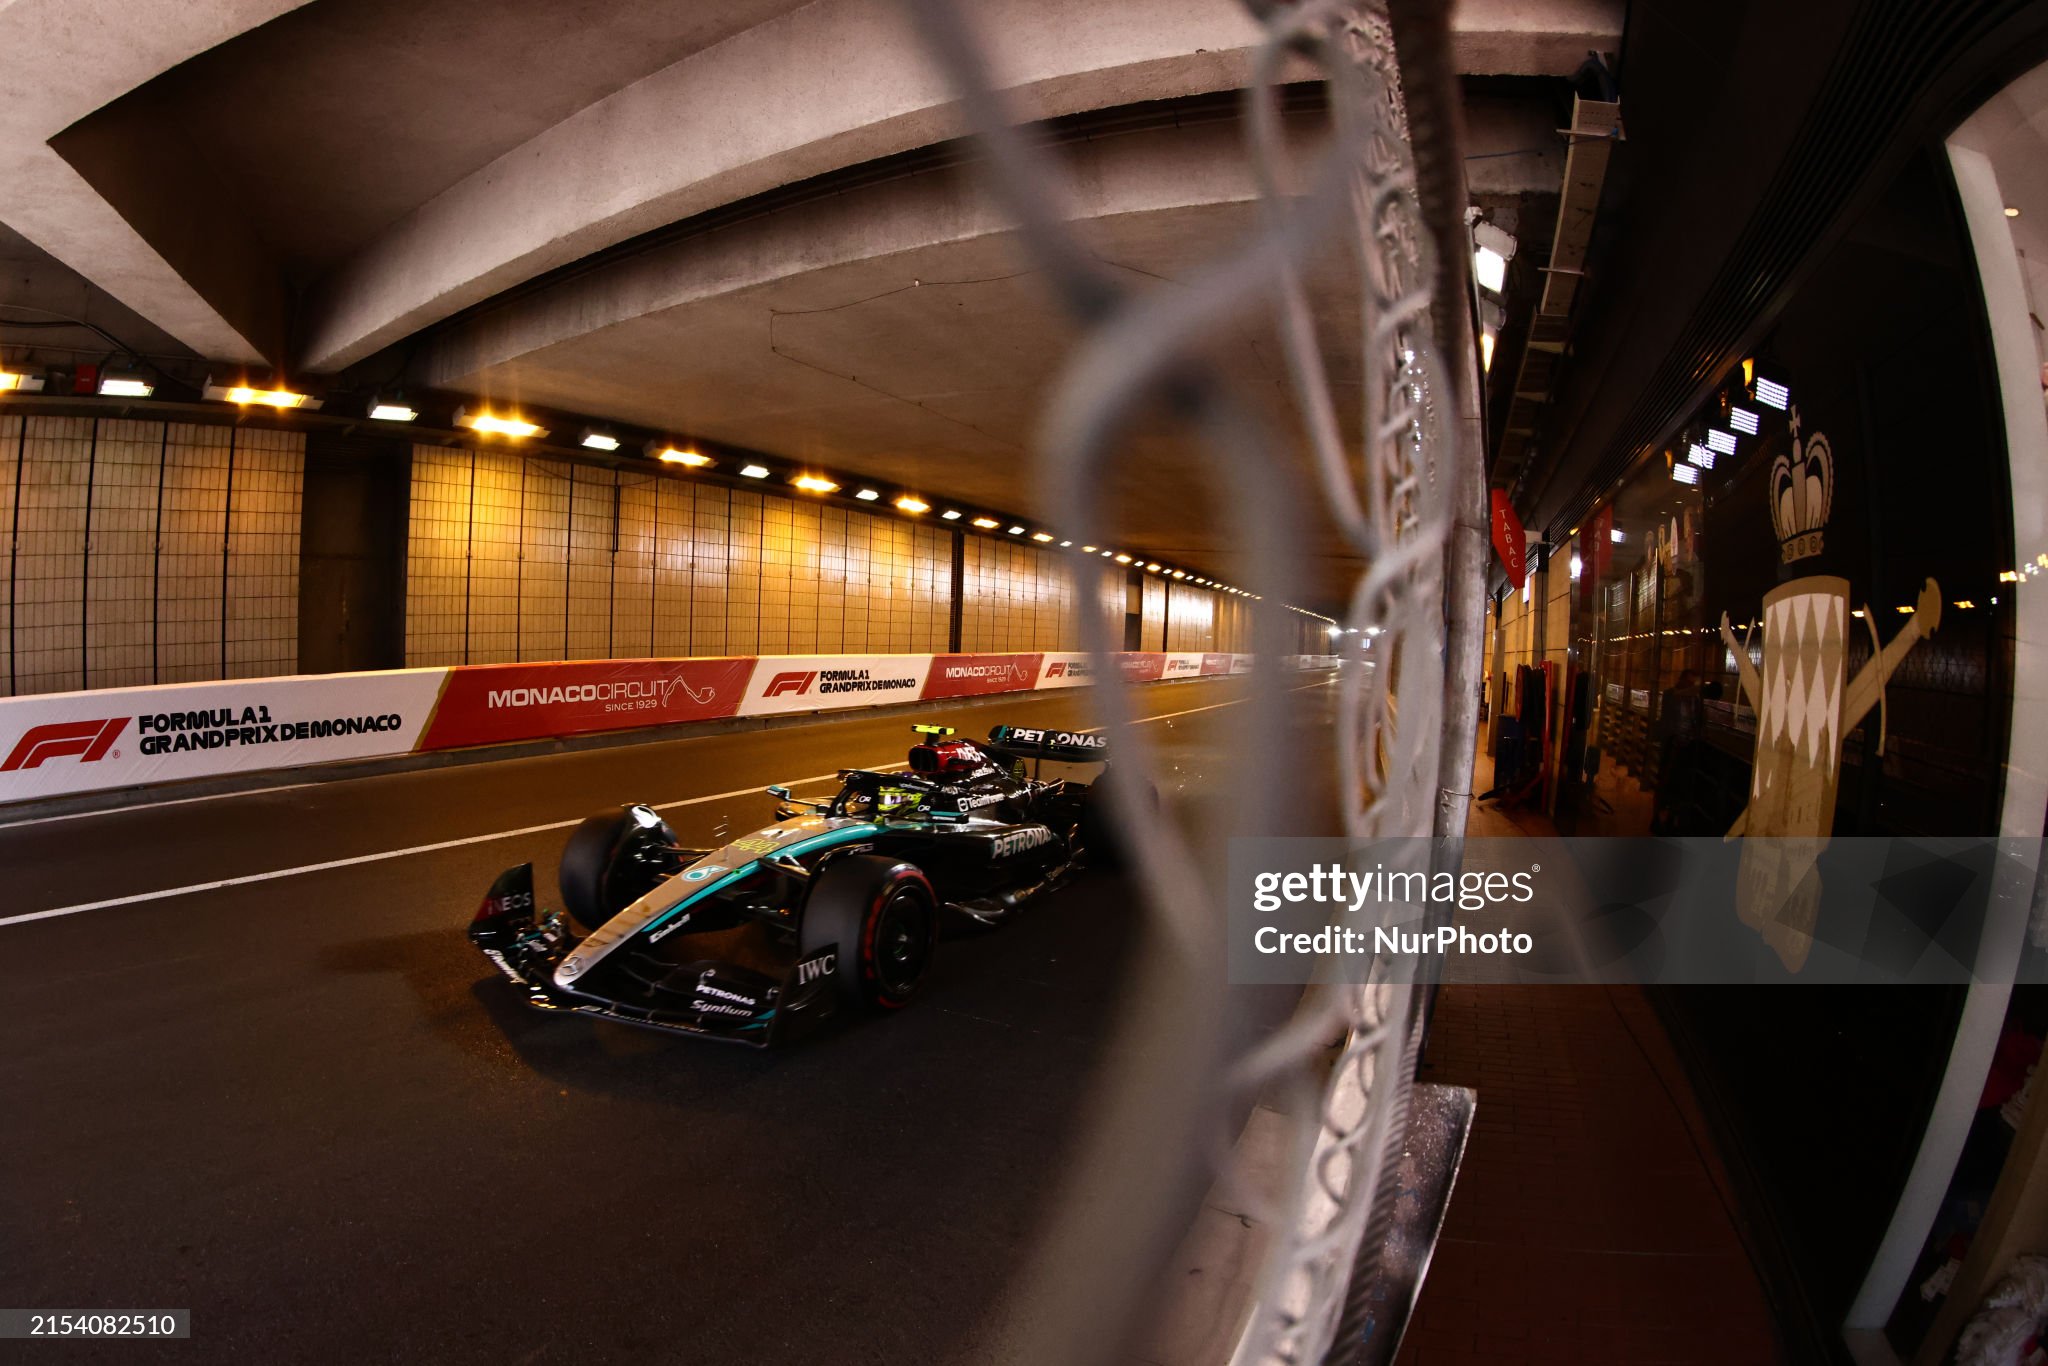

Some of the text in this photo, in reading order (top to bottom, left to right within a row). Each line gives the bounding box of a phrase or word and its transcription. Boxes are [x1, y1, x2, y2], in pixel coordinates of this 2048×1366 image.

[1499, 509, 1519, 568] TABAC
[762, 671, 819, 698] F1
[605, 699, 657, 712] SINCE 1929
[0, 717, 132, 771] F1
[1013, 728, 1108, 748] PETONAS
[487, 891, 532, 916] INEOS
[798, 954, 836, 985] IWC
[696, 984, 756, 1006] PETRONAS
[689, 999, 753, 1017] Syntium
